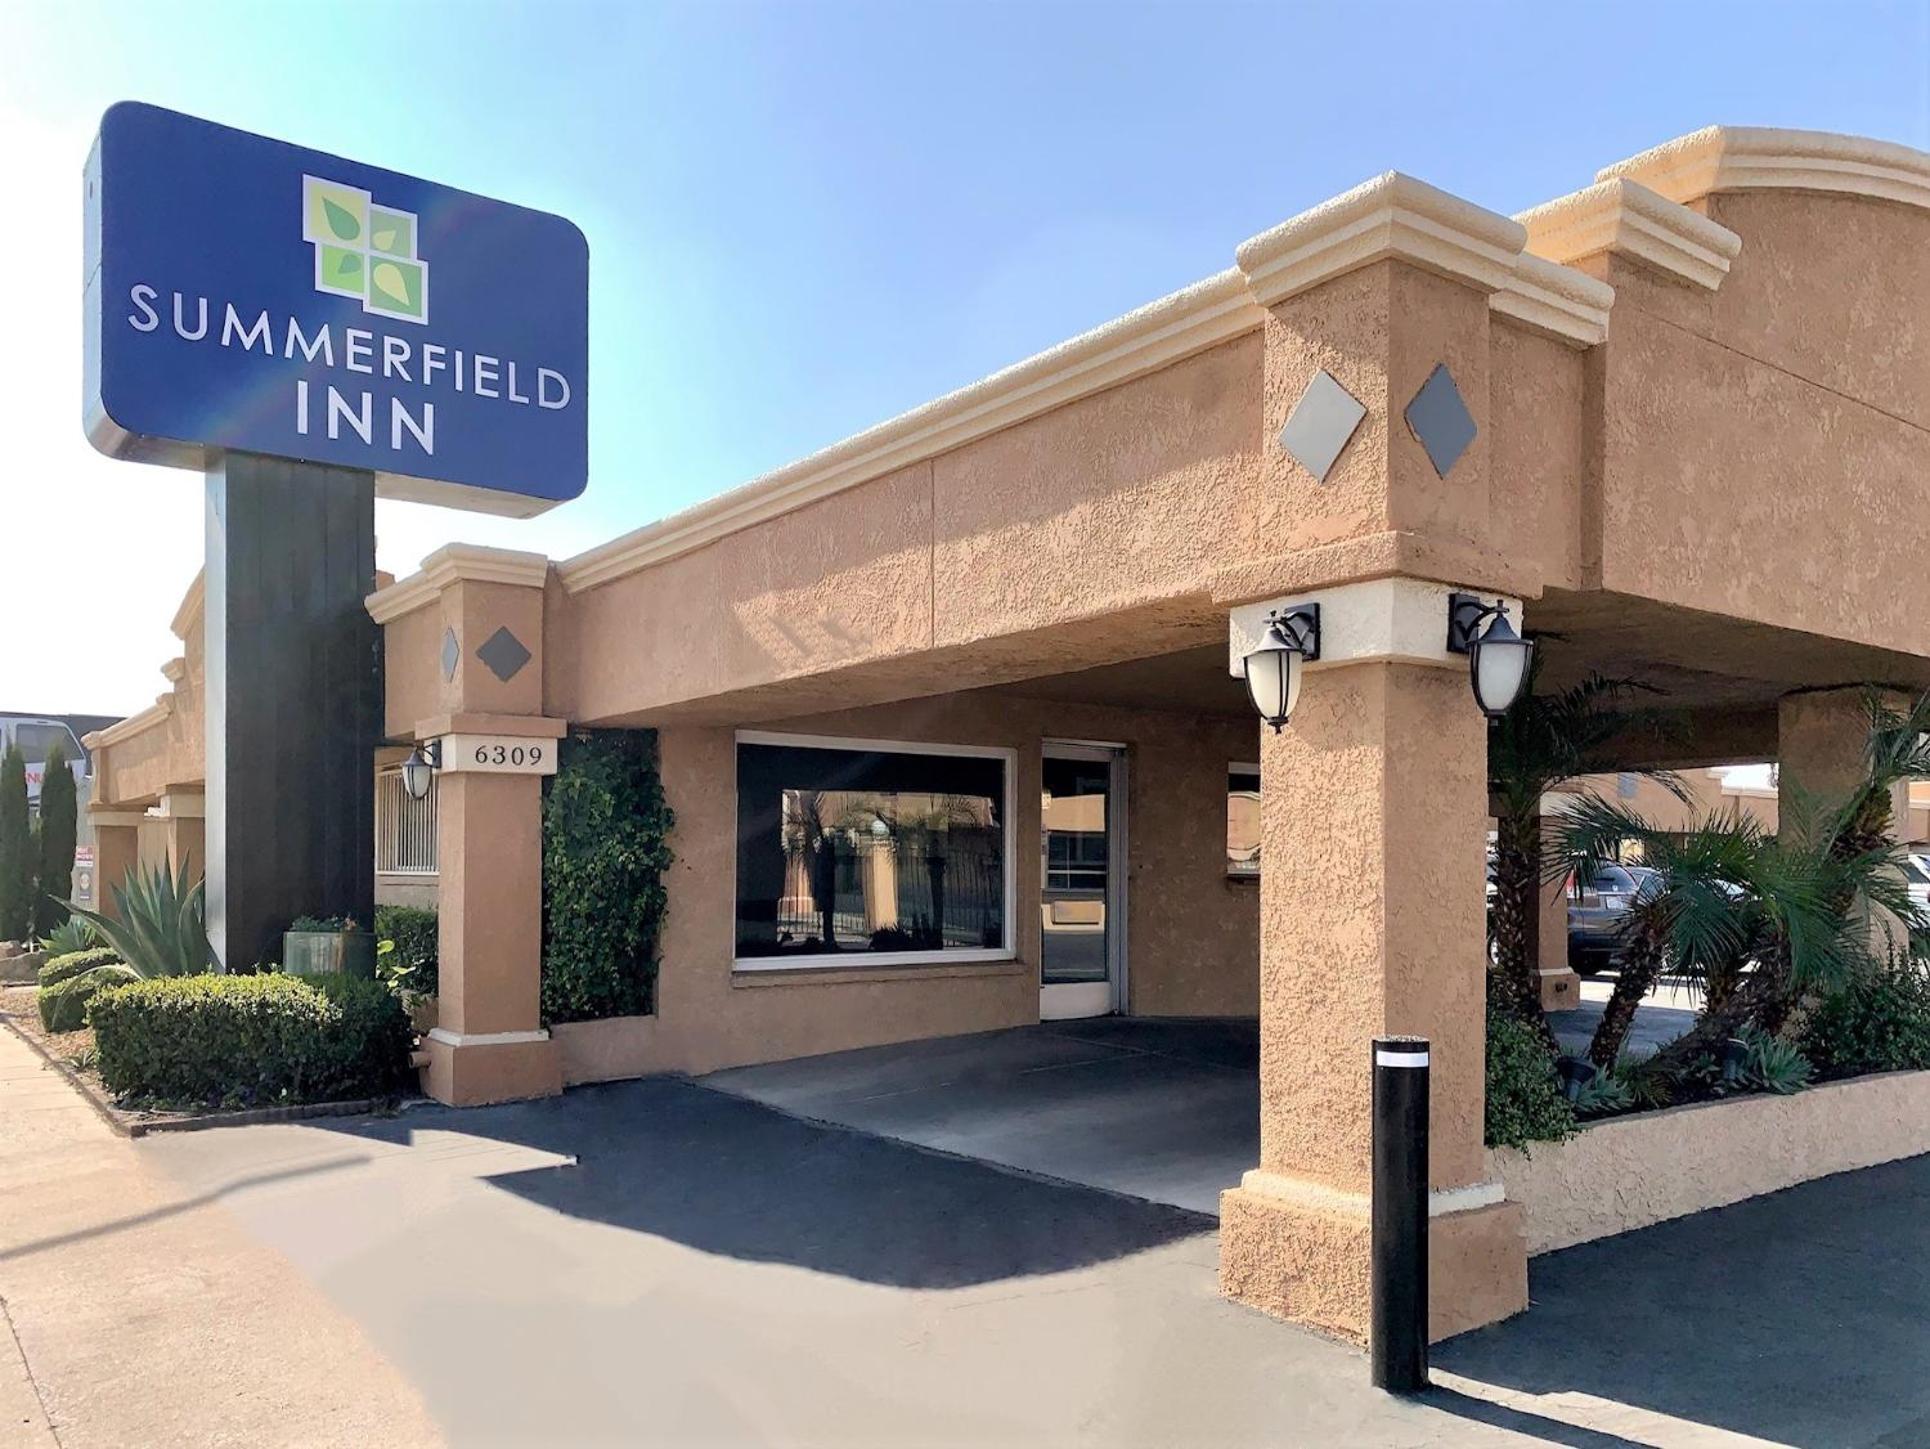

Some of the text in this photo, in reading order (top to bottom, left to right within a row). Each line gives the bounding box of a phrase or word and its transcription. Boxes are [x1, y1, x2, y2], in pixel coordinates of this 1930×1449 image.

[128, 284, 571, 410] SUMMERFIELD
[297, 380, 434, 455] INN
[475, 745, 542, 766] 6309
